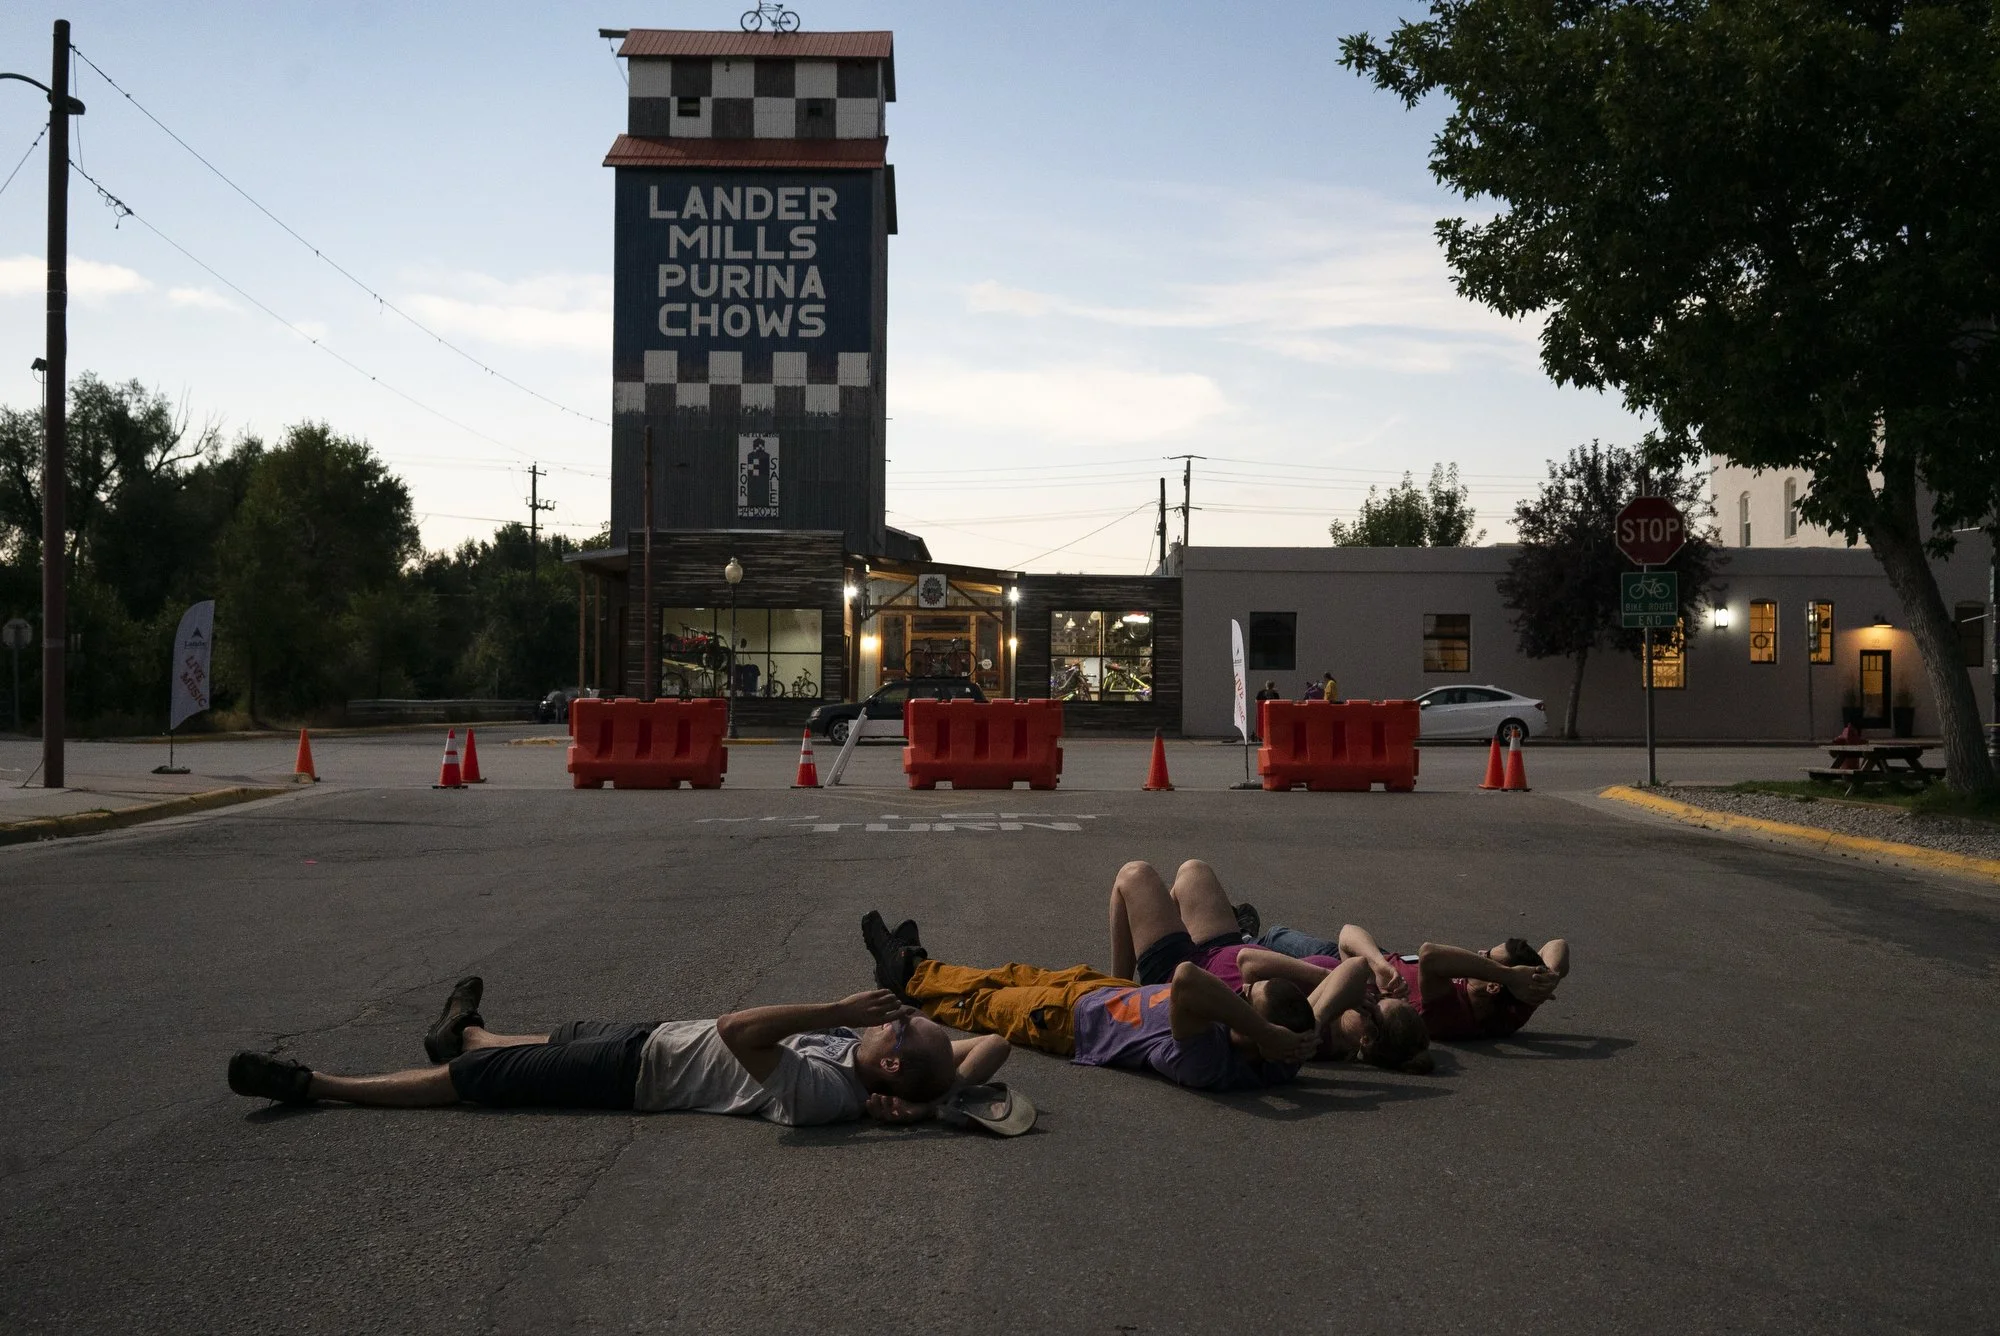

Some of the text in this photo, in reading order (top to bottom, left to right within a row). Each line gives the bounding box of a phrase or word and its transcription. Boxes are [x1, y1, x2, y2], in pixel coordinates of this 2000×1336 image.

[648, 185, 838, 221] LANDER
[669, 225, 817, 260] MILLS
[658, 264, 827, 300] PURINA
[658, 302, 827, 338] CHOWS
[740, 463, 748, 496] FOR
[770, 458, 779, 504] SALE
[1621, 518, 1680, 543] STOP
[1625, 602, 1674, 612] BIKE ROUTE
[1638, 616, 1662, 626] END
[185, 655, 205, 682] LIVE
[180, 671, 208, 708] MUSIC
[788, 822, 1082, 832] TURN
